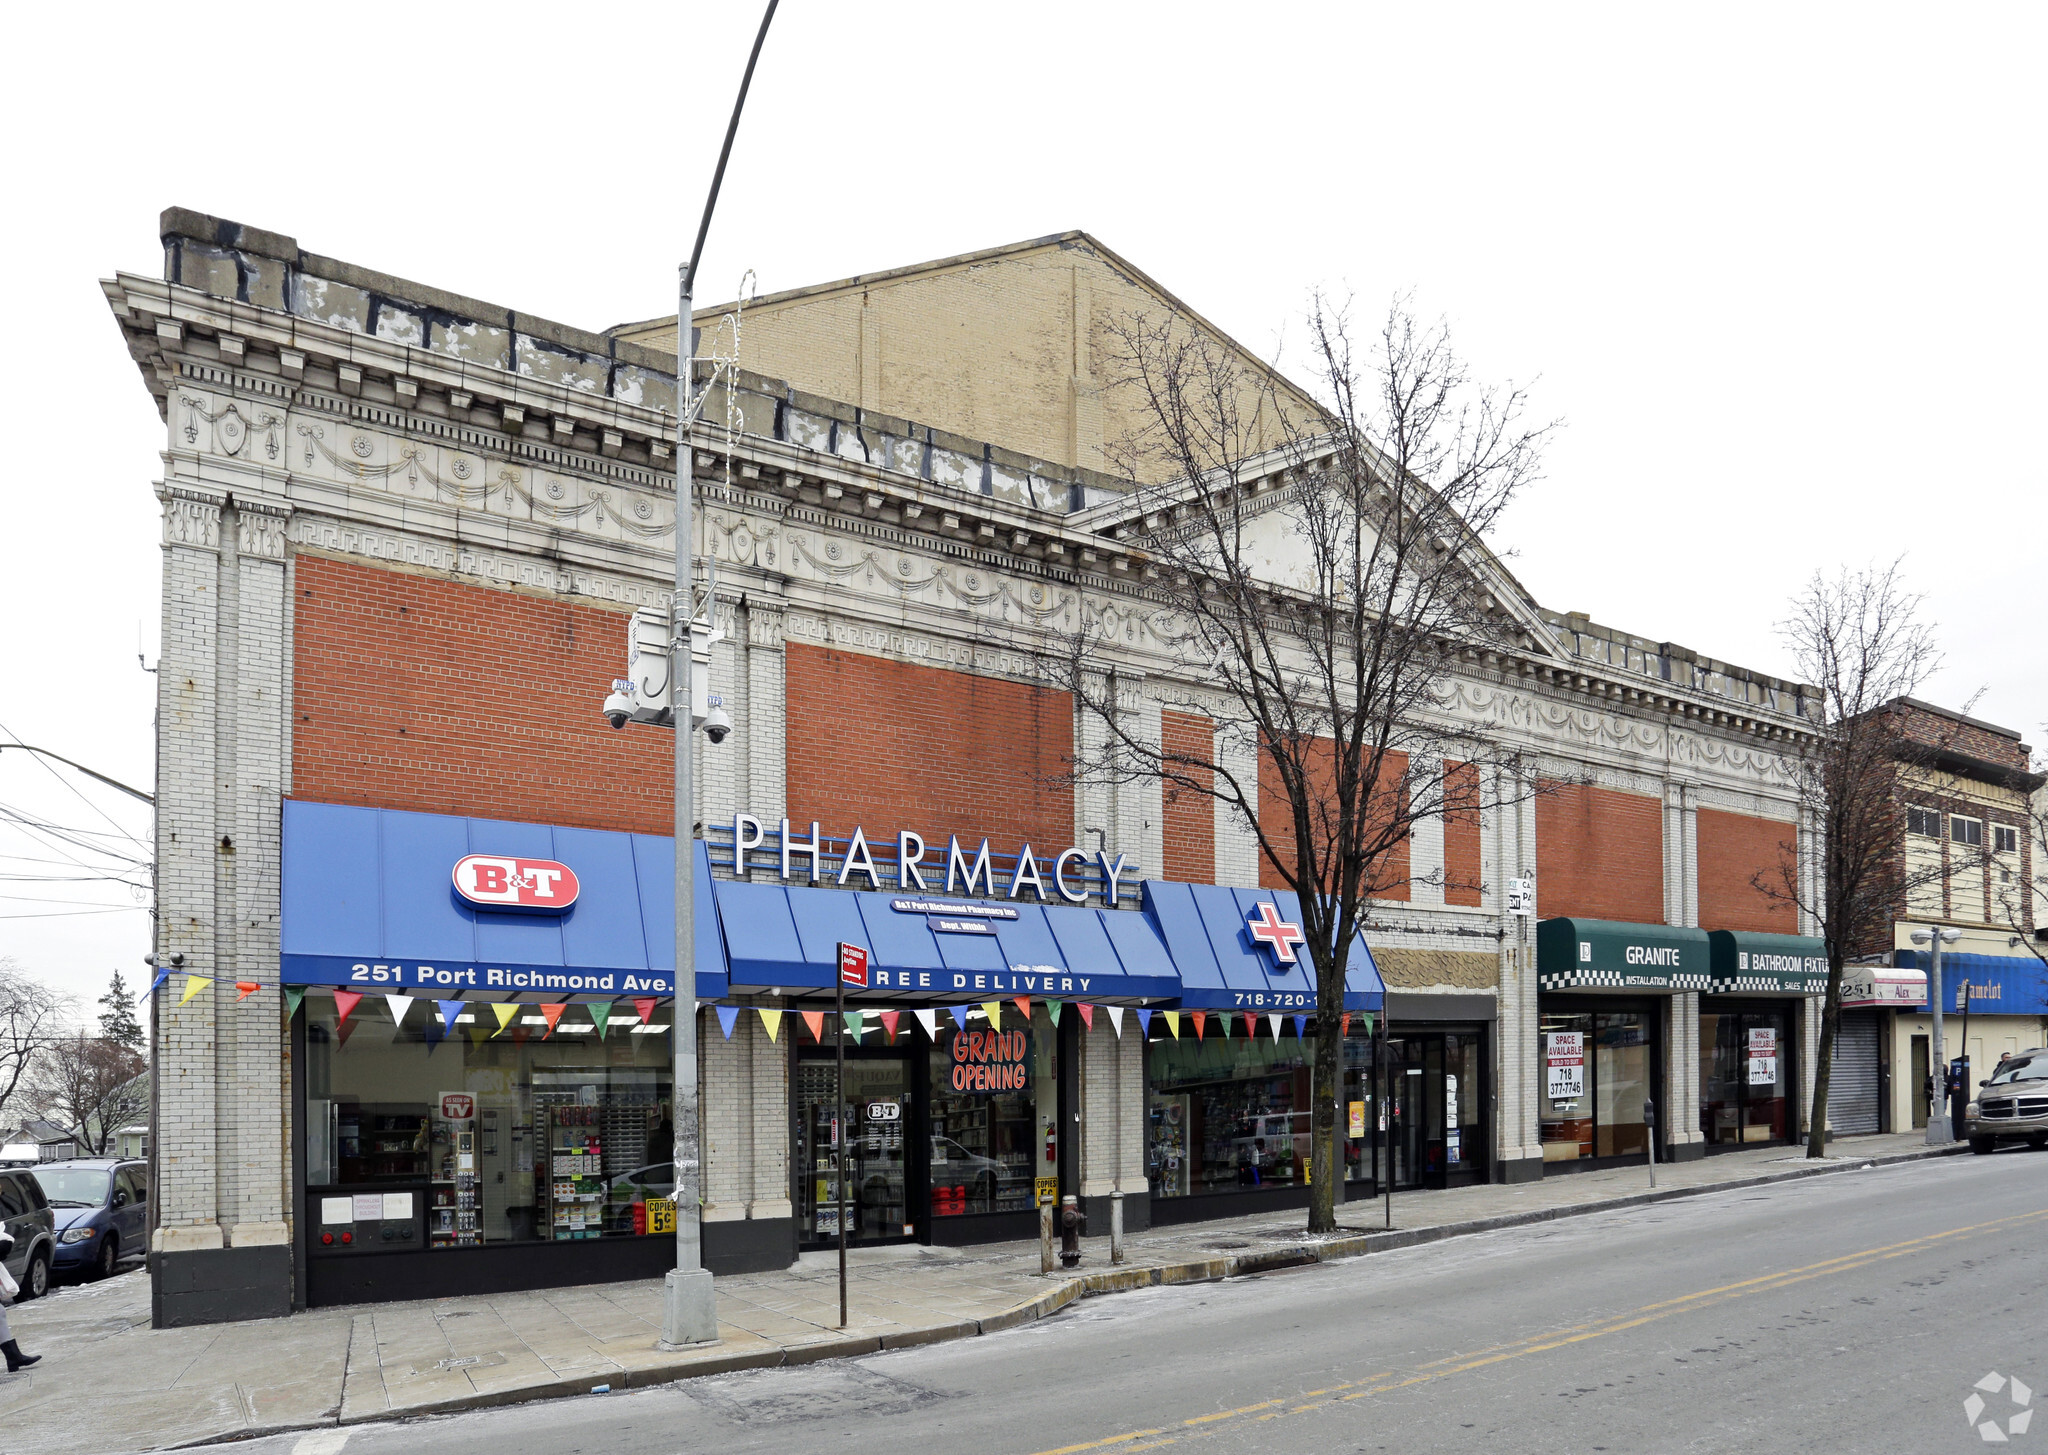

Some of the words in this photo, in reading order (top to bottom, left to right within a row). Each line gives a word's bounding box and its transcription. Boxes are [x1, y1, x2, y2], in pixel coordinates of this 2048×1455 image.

[616, 679, 635, 691] NYPD
[733, 812, 1128, 906] PHARMACY
[472, 864, 562, 898] B&T
[911, 901, 929, 911] Port
[928, 902, 967, 913] Richmond
[967, 905, 1004, 916] Pharmacy
[960, 922, 987, 931] Within
[1626, 946, 1680, 966] GRANITE
[1752, 953, 1802, 972] BATHROOM
[351, 963, 403, 982] 251
[417, 966, 477, 985] Port
[487, 969, 614, 990] Richmond
[623, 974, 675, 992] Ave.
[876, 970, 931, 987] REE
[953, 974, 1091, 992] DELIVERY
[1626, 976, 1668, 986] INSTALLATION
[1784, 981, 1801, 990] SALES
[1555, 1035, 1576, 1045] SPACE
[1755, 1030, 1770, 1039] SPACE
[953, 1031, 1027, 1063] GRAND
[1549, 1046, 1582, 1056] AVAILABLE
[952, 1063, 1026, 1091] OPENING
[1560, 1068, 1573, 1081] 718
[1550, 1081, 1581, 1095] 377-7746
[446, 1104, 470, 1117] TV
[1037, 1180, 1057, 1188] COPIES
[649, 1201, 677, 1212] COPIES
